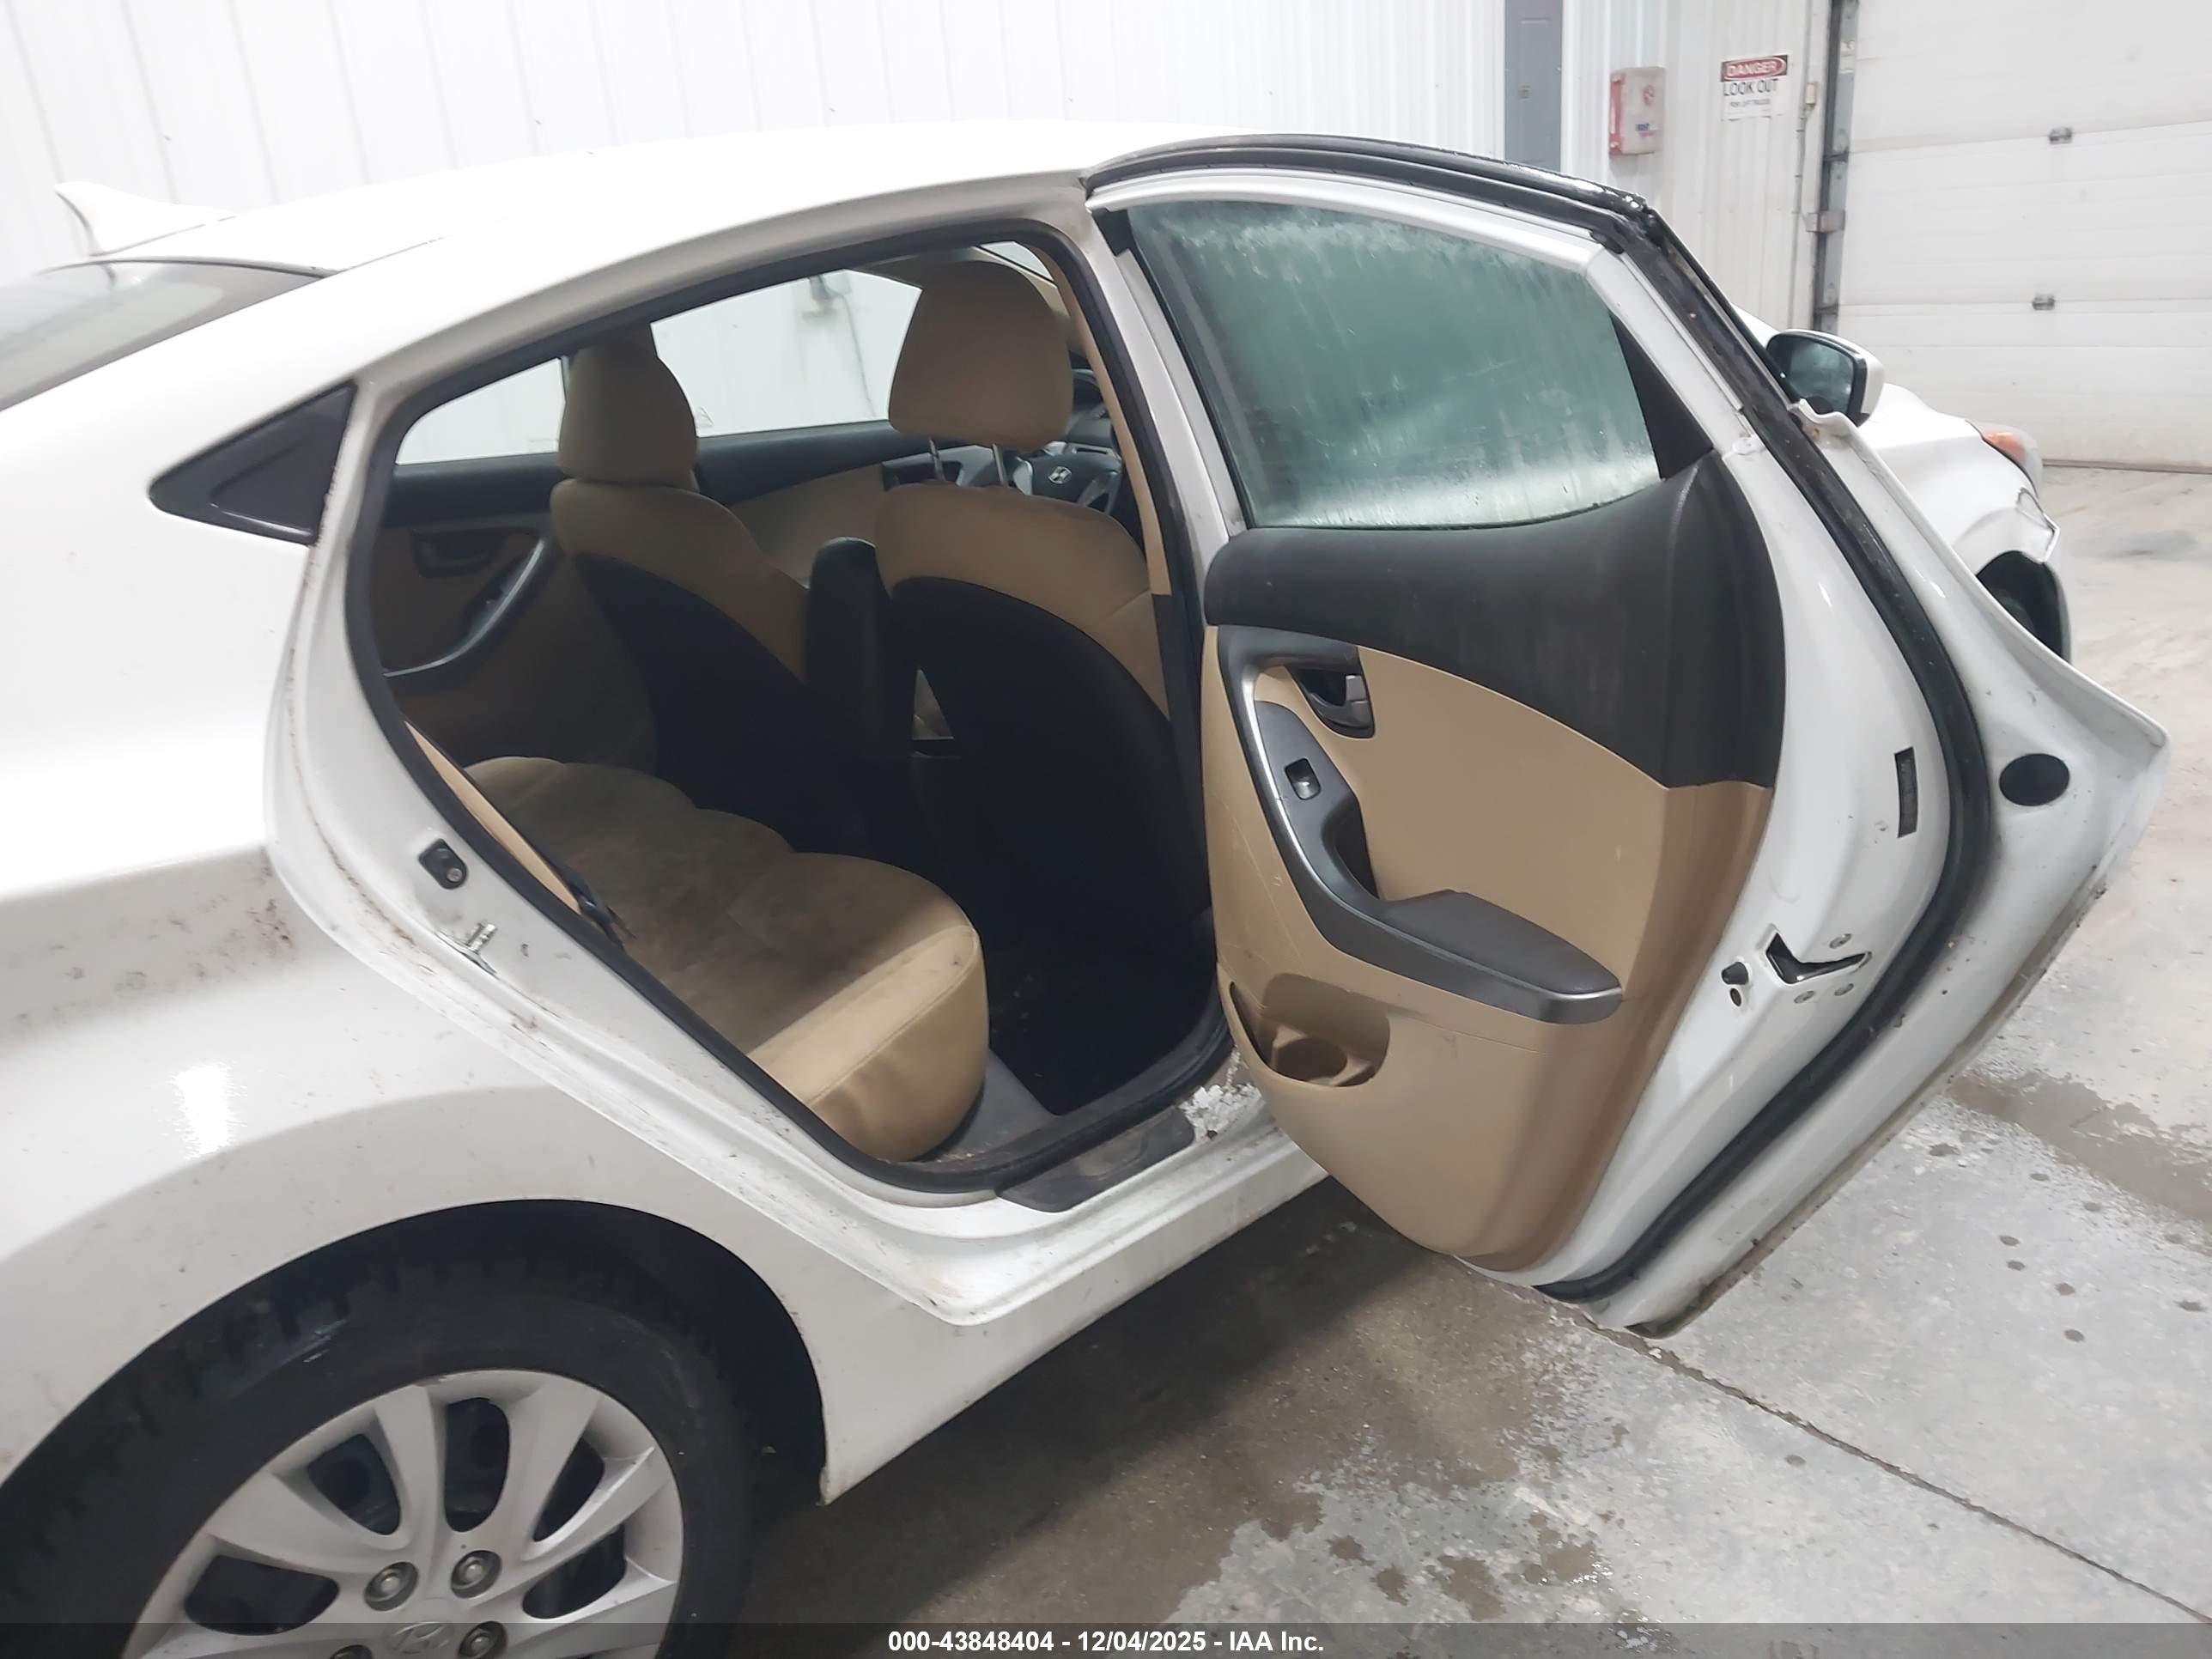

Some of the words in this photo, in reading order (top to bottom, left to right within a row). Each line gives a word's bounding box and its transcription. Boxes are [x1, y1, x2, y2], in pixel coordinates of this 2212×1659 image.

[1726, 60, 1777, 76] DANGER
[1723, 82, 1754, 96] LOOK
[1757, 78, 1778, 93] OUT
